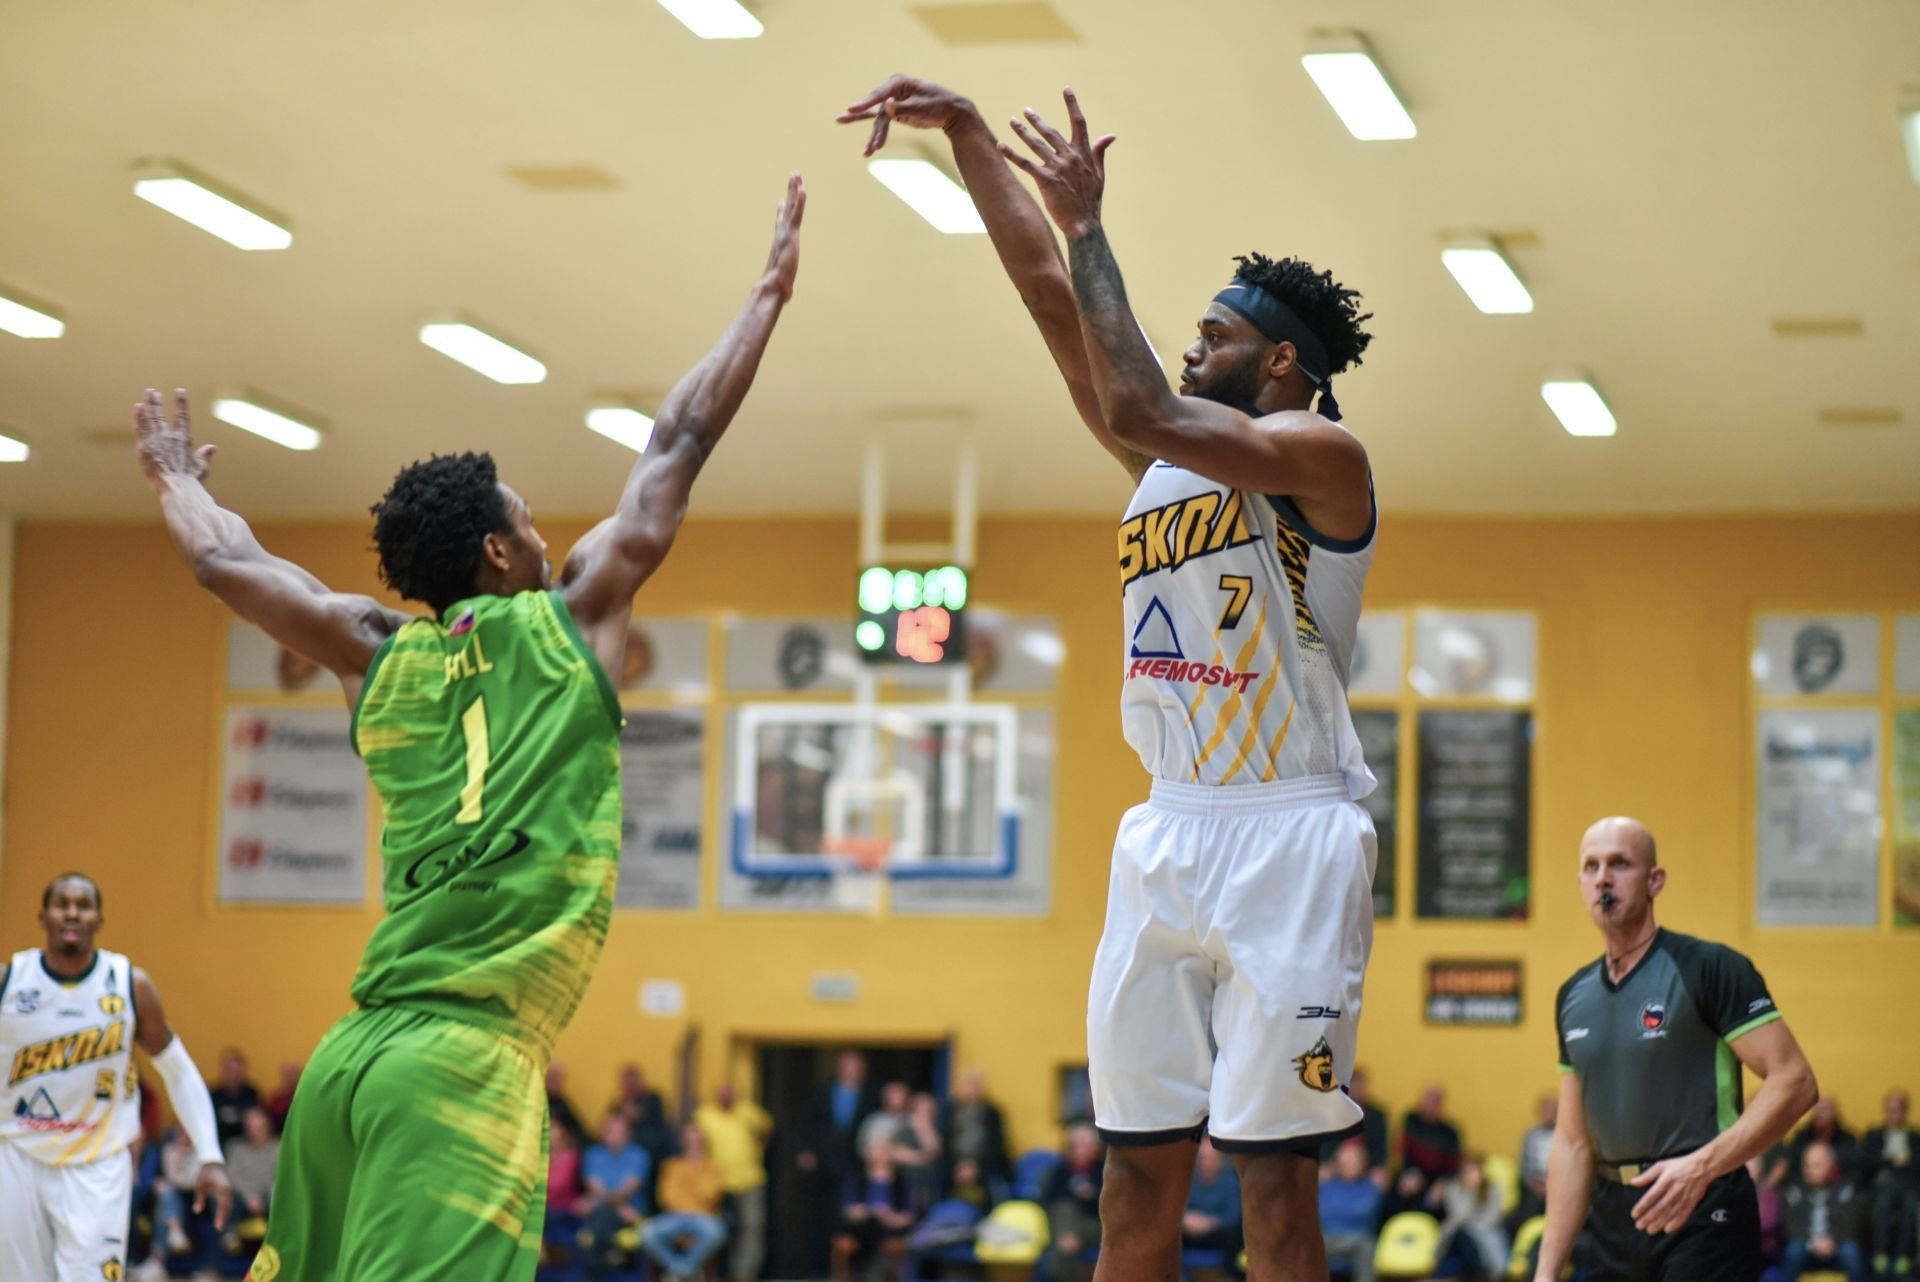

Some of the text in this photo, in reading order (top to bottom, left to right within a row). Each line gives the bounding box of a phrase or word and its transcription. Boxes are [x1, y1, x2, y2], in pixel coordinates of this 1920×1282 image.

[1118, 488, 1262, 597] SKRA
[1219, 575, 1253, 629] 7
[1126, 659, 1260, 694] HEMOSVIT
[455, 695, 490, 824] 1
[8, 1020, 123, 1087] ISKRA
